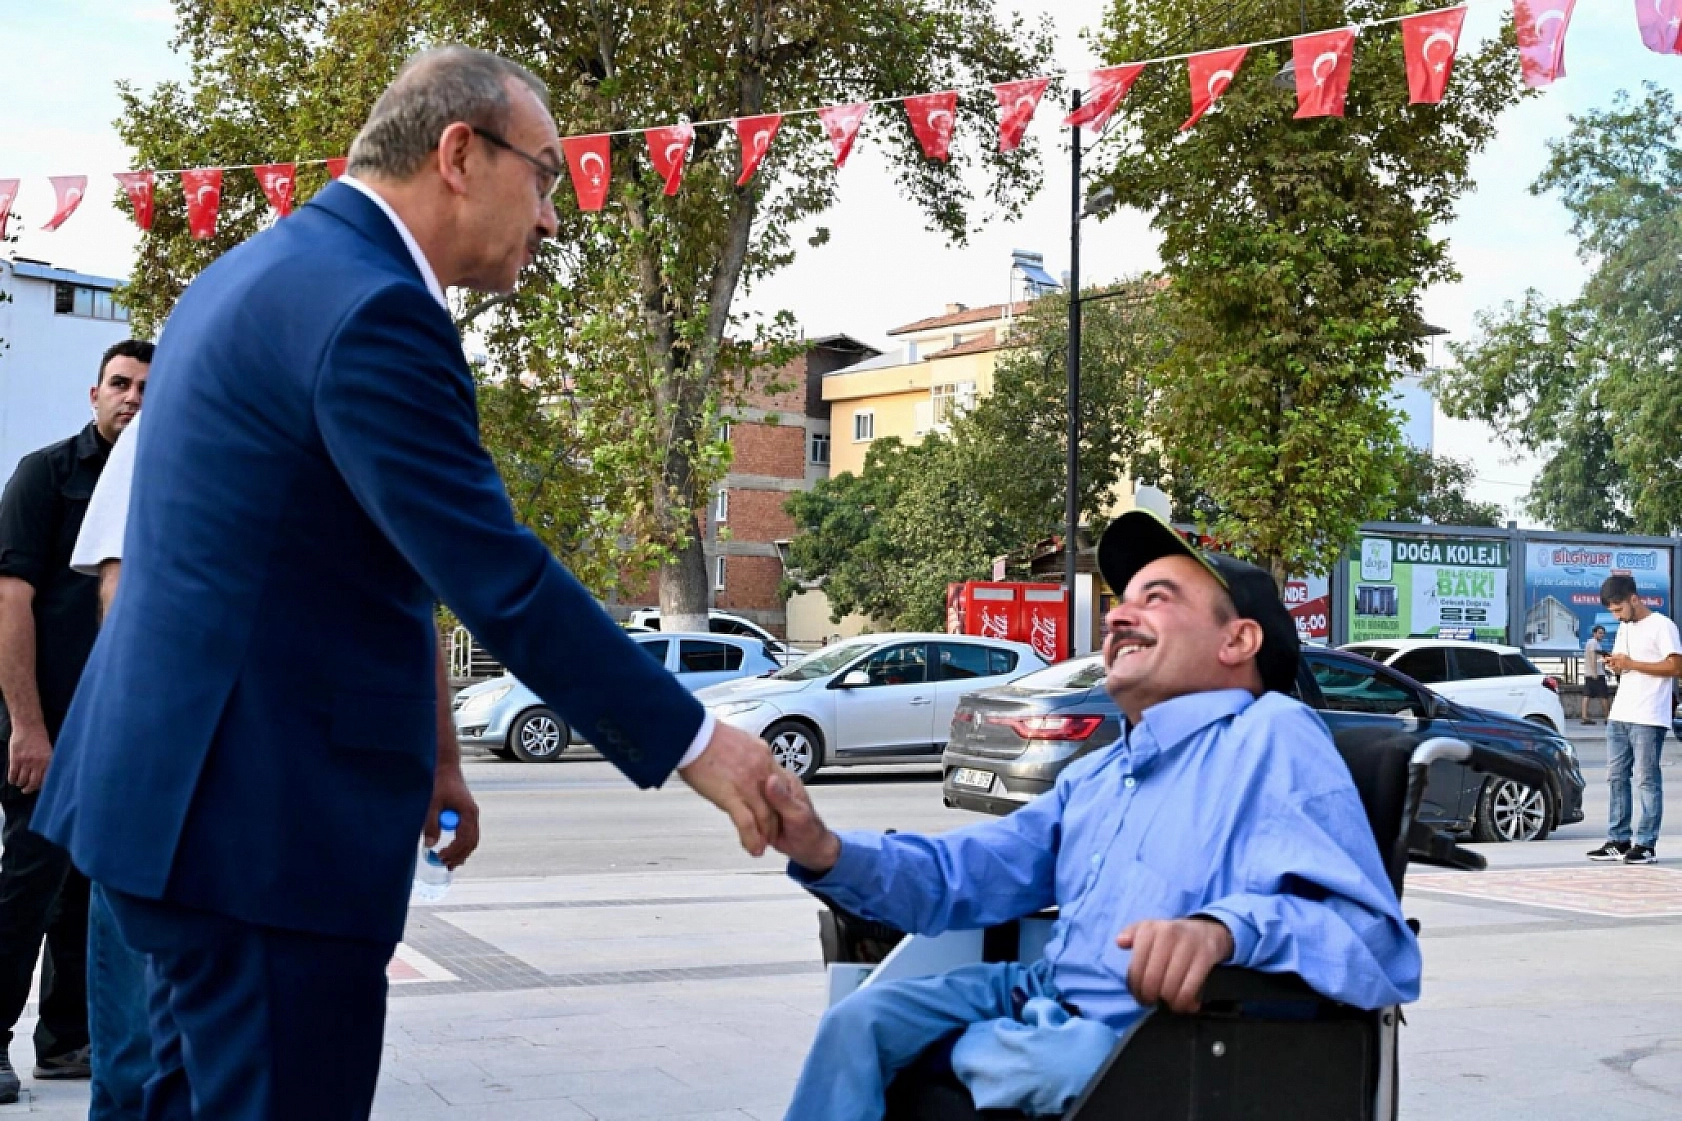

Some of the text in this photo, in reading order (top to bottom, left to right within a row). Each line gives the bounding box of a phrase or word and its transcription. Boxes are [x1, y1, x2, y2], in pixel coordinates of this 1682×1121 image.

[1396, 540, 1501, 565] DOĞA KOLEJİ
[1553, 547, 1657, 570] BİLGİYURT KOLEJİ
[1437, 575, 1495, 598] BAK!
